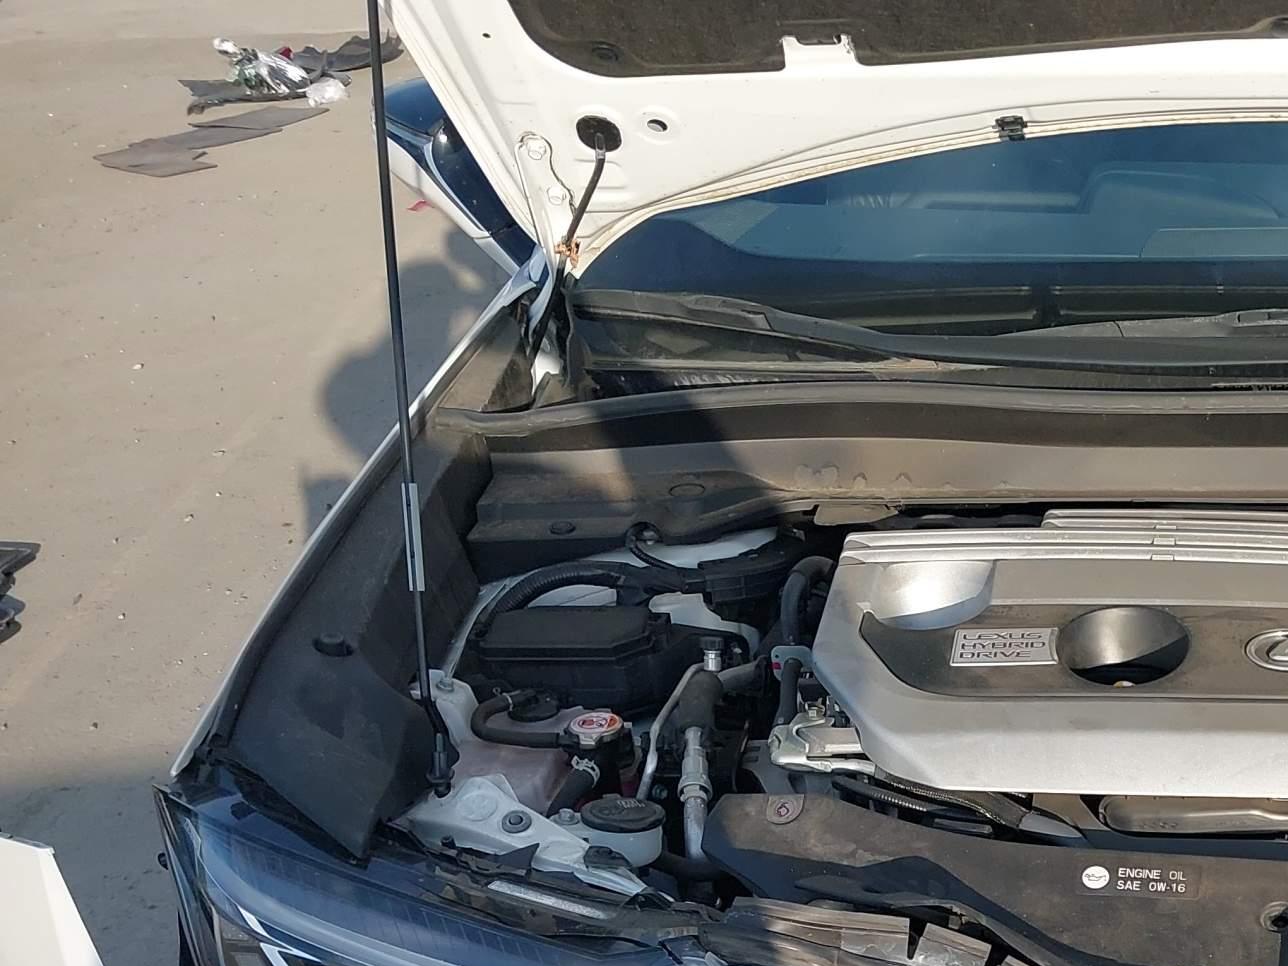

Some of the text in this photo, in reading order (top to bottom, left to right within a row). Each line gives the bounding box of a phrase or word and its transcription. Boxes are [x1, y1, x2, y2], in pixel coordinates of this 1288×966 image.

[962, 631, 1042, 641] LEXUS
[960, 641, 1046, 650] HYBRID
[959, 650, 1032, 660] DRIVE
[1117, 867, 1187, 881] ENGINE OIL
[1116, 880, 1187, 893] SAE 0W-16
